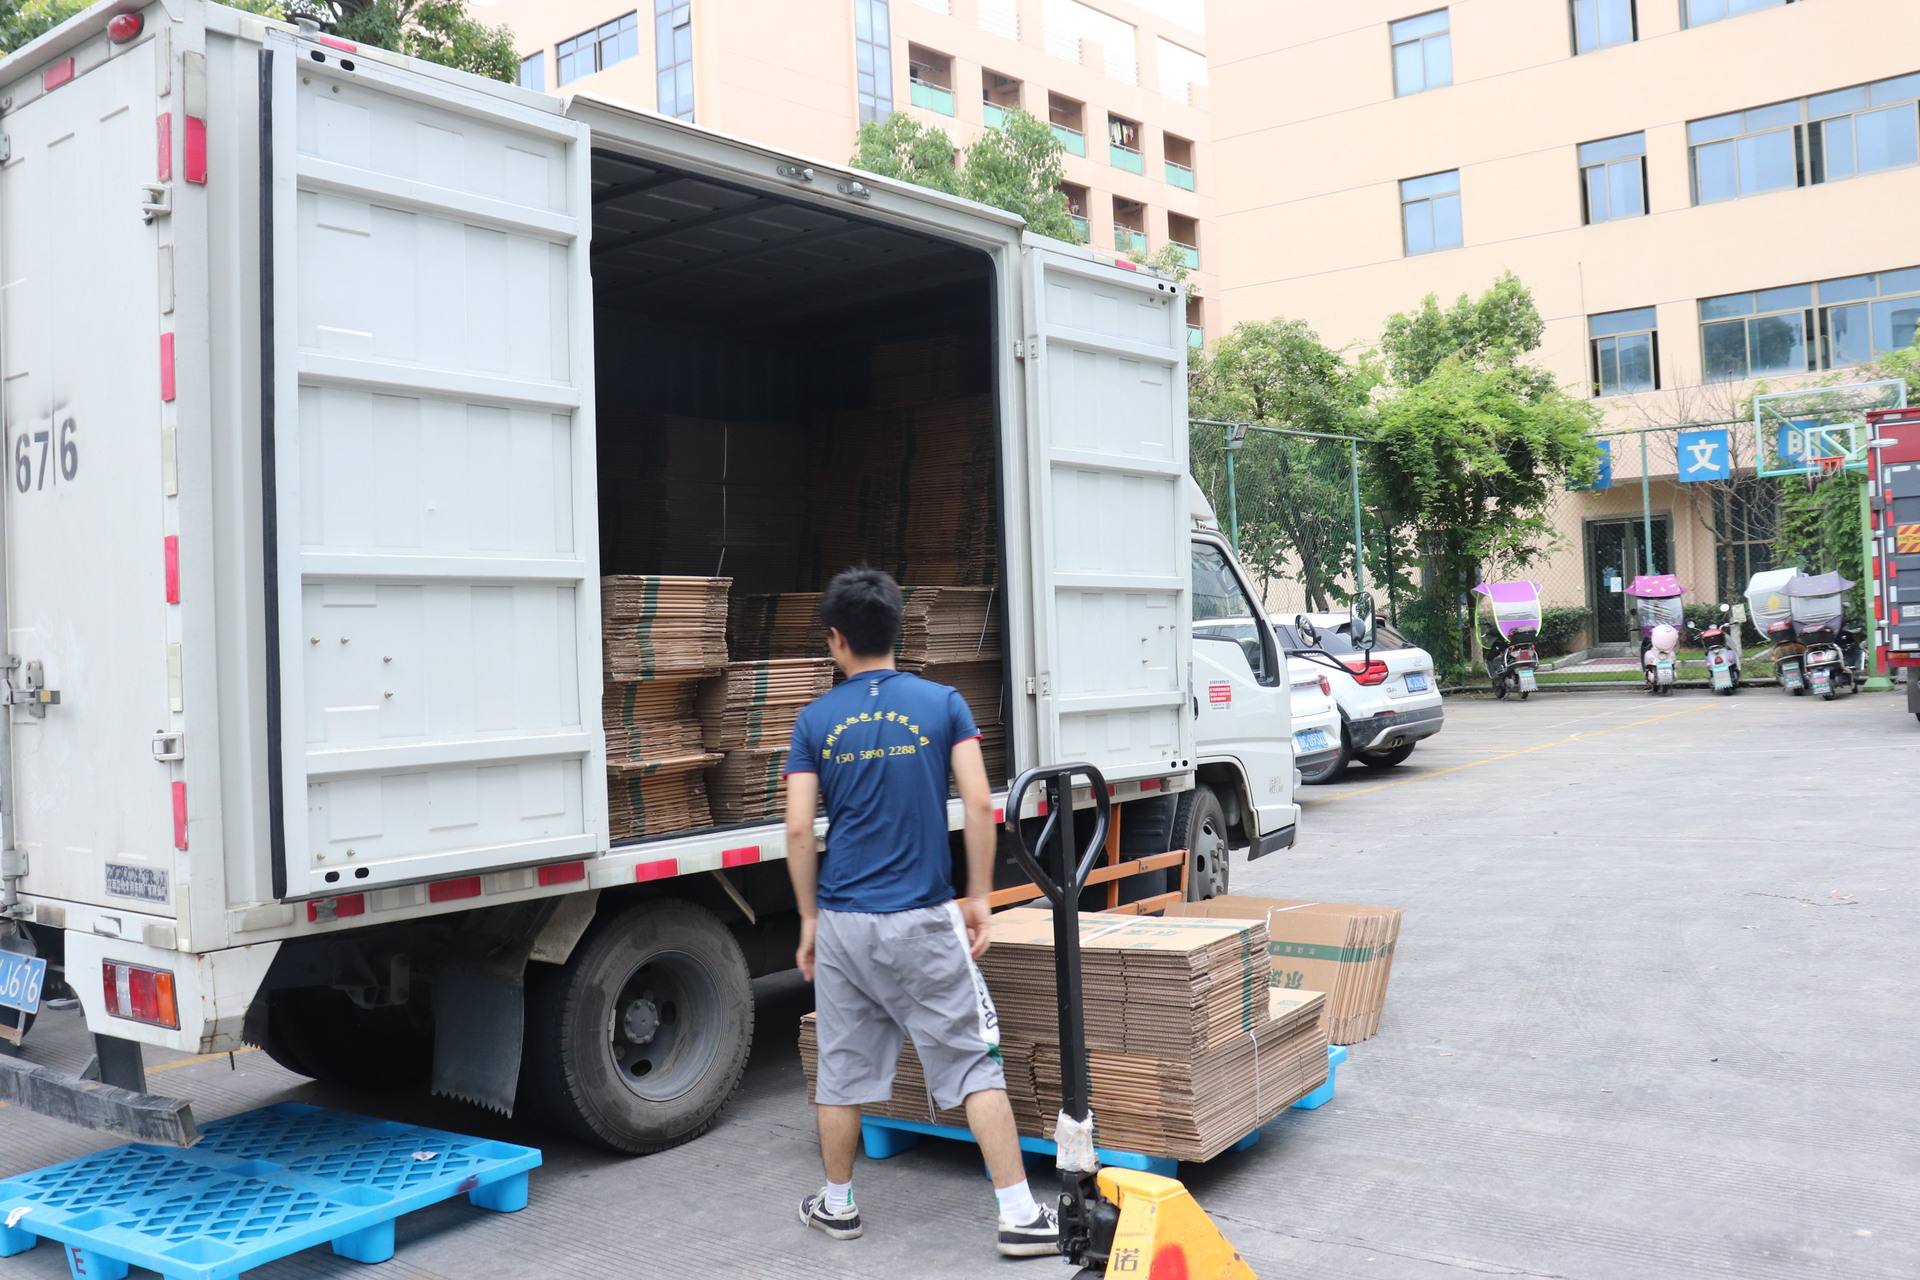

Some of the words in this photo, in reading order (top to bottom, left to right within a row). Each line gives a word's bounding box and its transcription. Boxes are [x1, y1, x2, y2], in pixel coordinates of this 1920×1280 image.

[15, 417, 78, 494] 676
[1687, 439, 1721, 474] 文
[1788, 430, 1821, 461] 明
[888, 744, 916, 756] 2288
[0, 958, 40, 1004] J676
[1113, 1247, 1141, 1272] 诺
